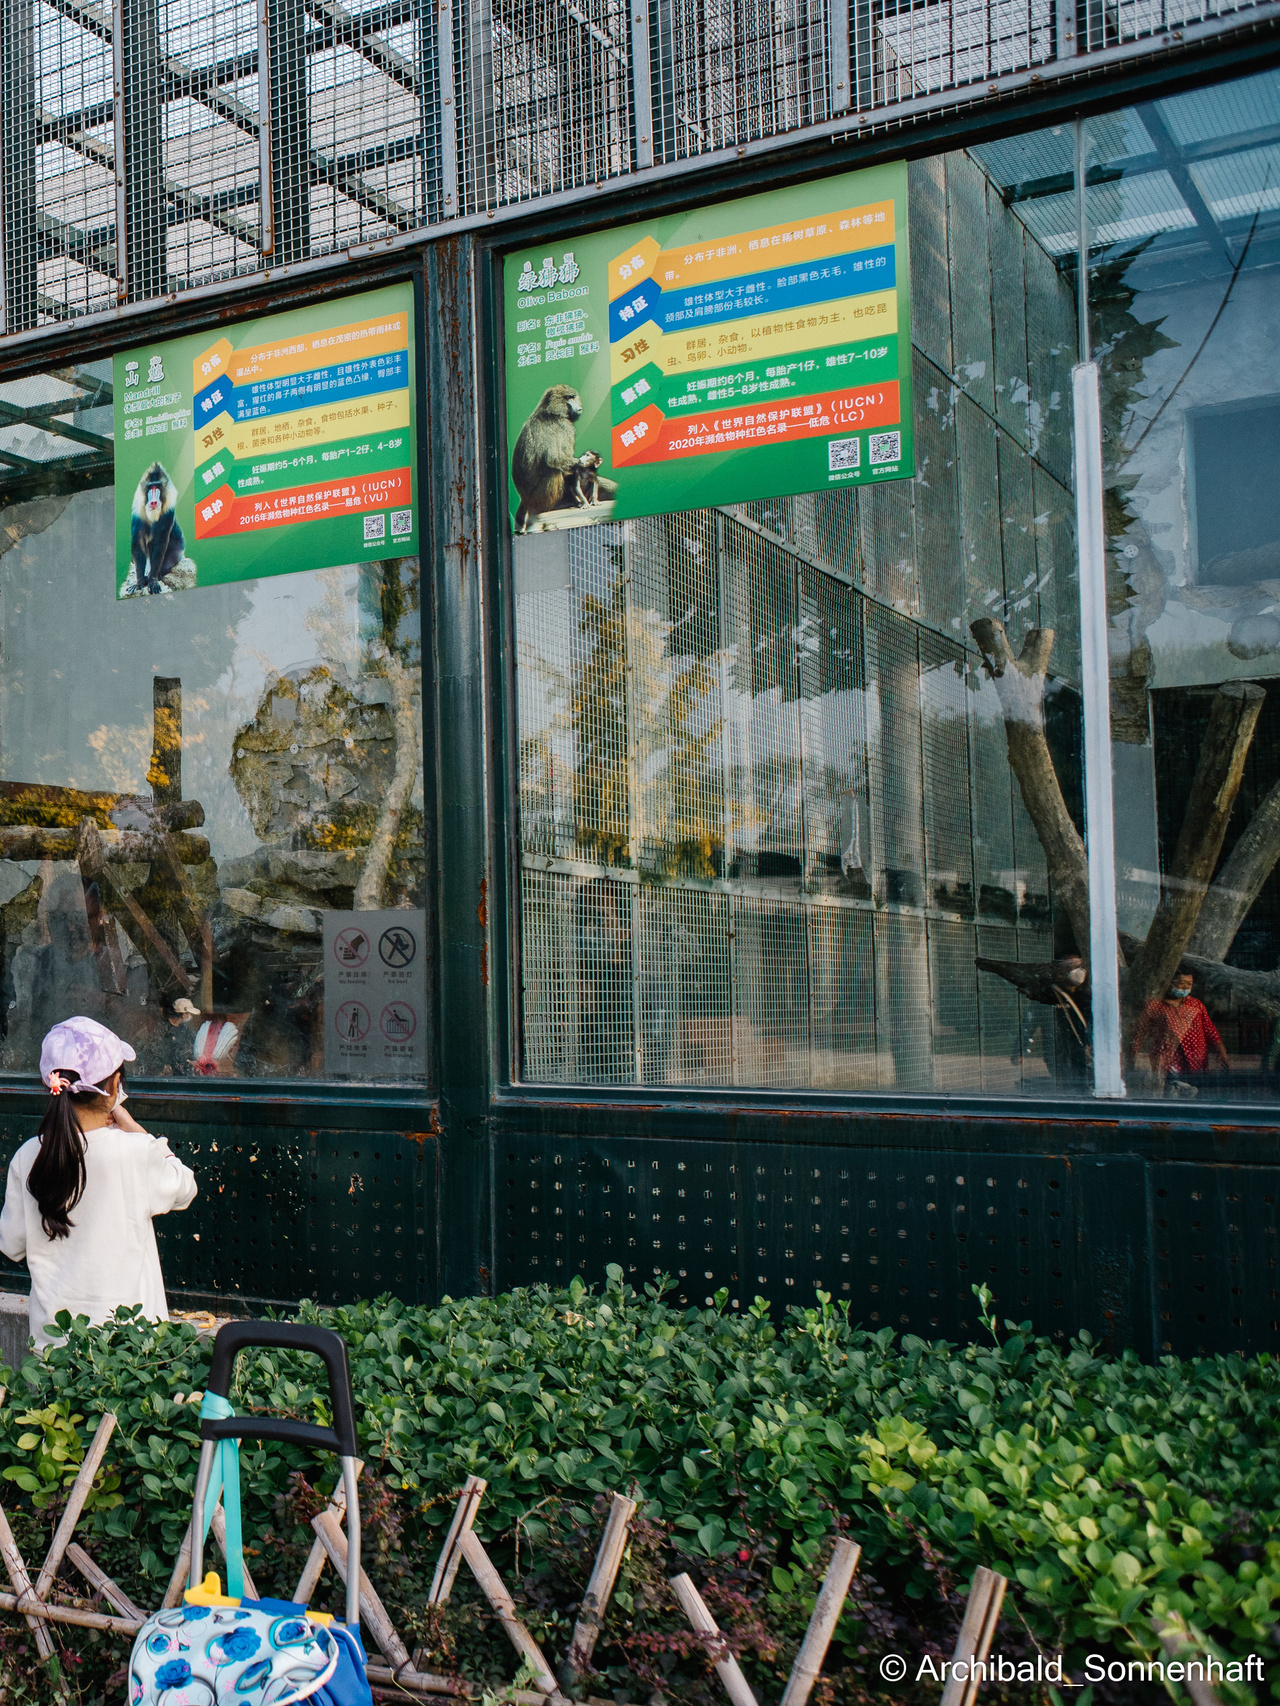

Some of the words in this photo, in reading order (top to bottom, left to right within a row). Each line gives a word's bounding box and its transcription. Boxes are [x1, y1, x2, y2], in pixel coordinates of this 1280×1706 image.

[517, 262, 580, 292] 绿狒狒
[618, 253, 646, 280] 分布
[517, 295, 546, 309] Olive
[547, 285, 589, 303] Baboon
[618, 295, 649, 323] 特征
[620, 338, 650, 364] 习性
[201, 353, 221, 376] 分布
[124, 385, 160, 402] Mandrill
[200, 389, 224, 413] 特征
[201, 427, 225, 448] 习性
[619, 421, 649, 448] 保护
[201, 499, 224, 522] 保护
